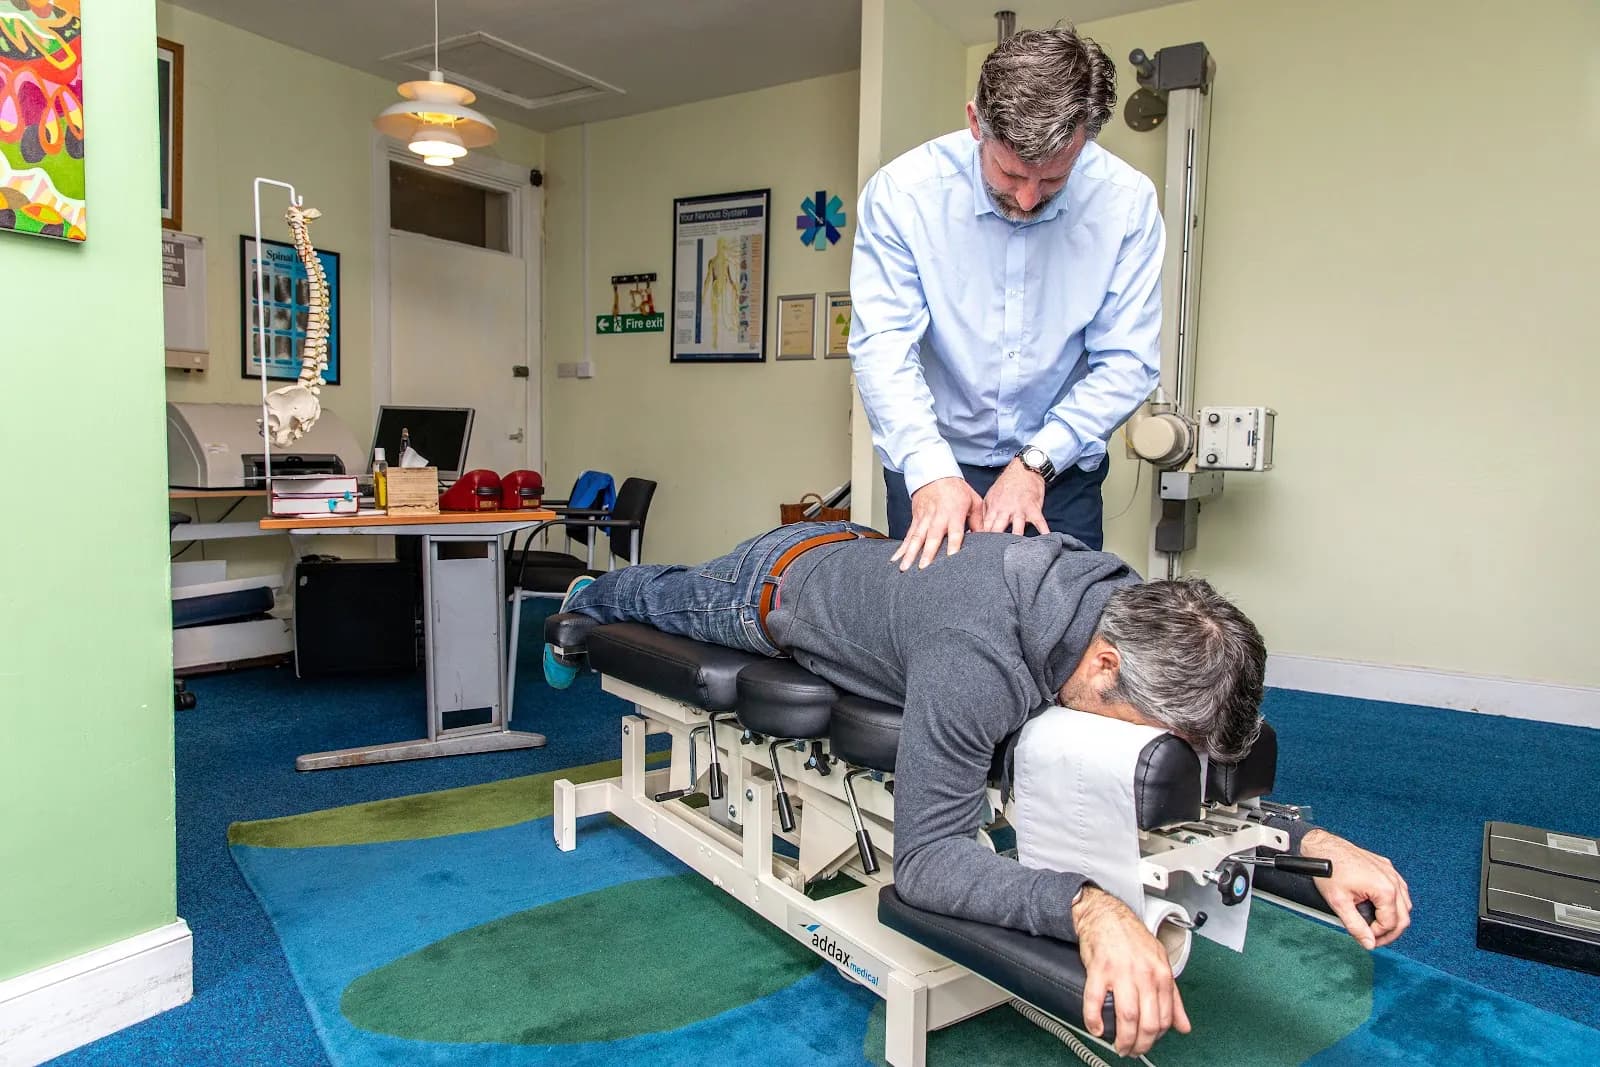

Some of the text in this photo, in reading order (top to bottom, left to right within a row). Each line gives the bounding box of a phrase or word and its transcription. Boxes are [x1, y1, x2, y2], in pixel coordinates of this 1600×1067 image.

[680, 208, 748, 222] Your Nervous System
[266, 249, 293, 262] Spinal
[626, 317, 663, 329] Fire exit
[811, 933, 879, 986] addax medical
